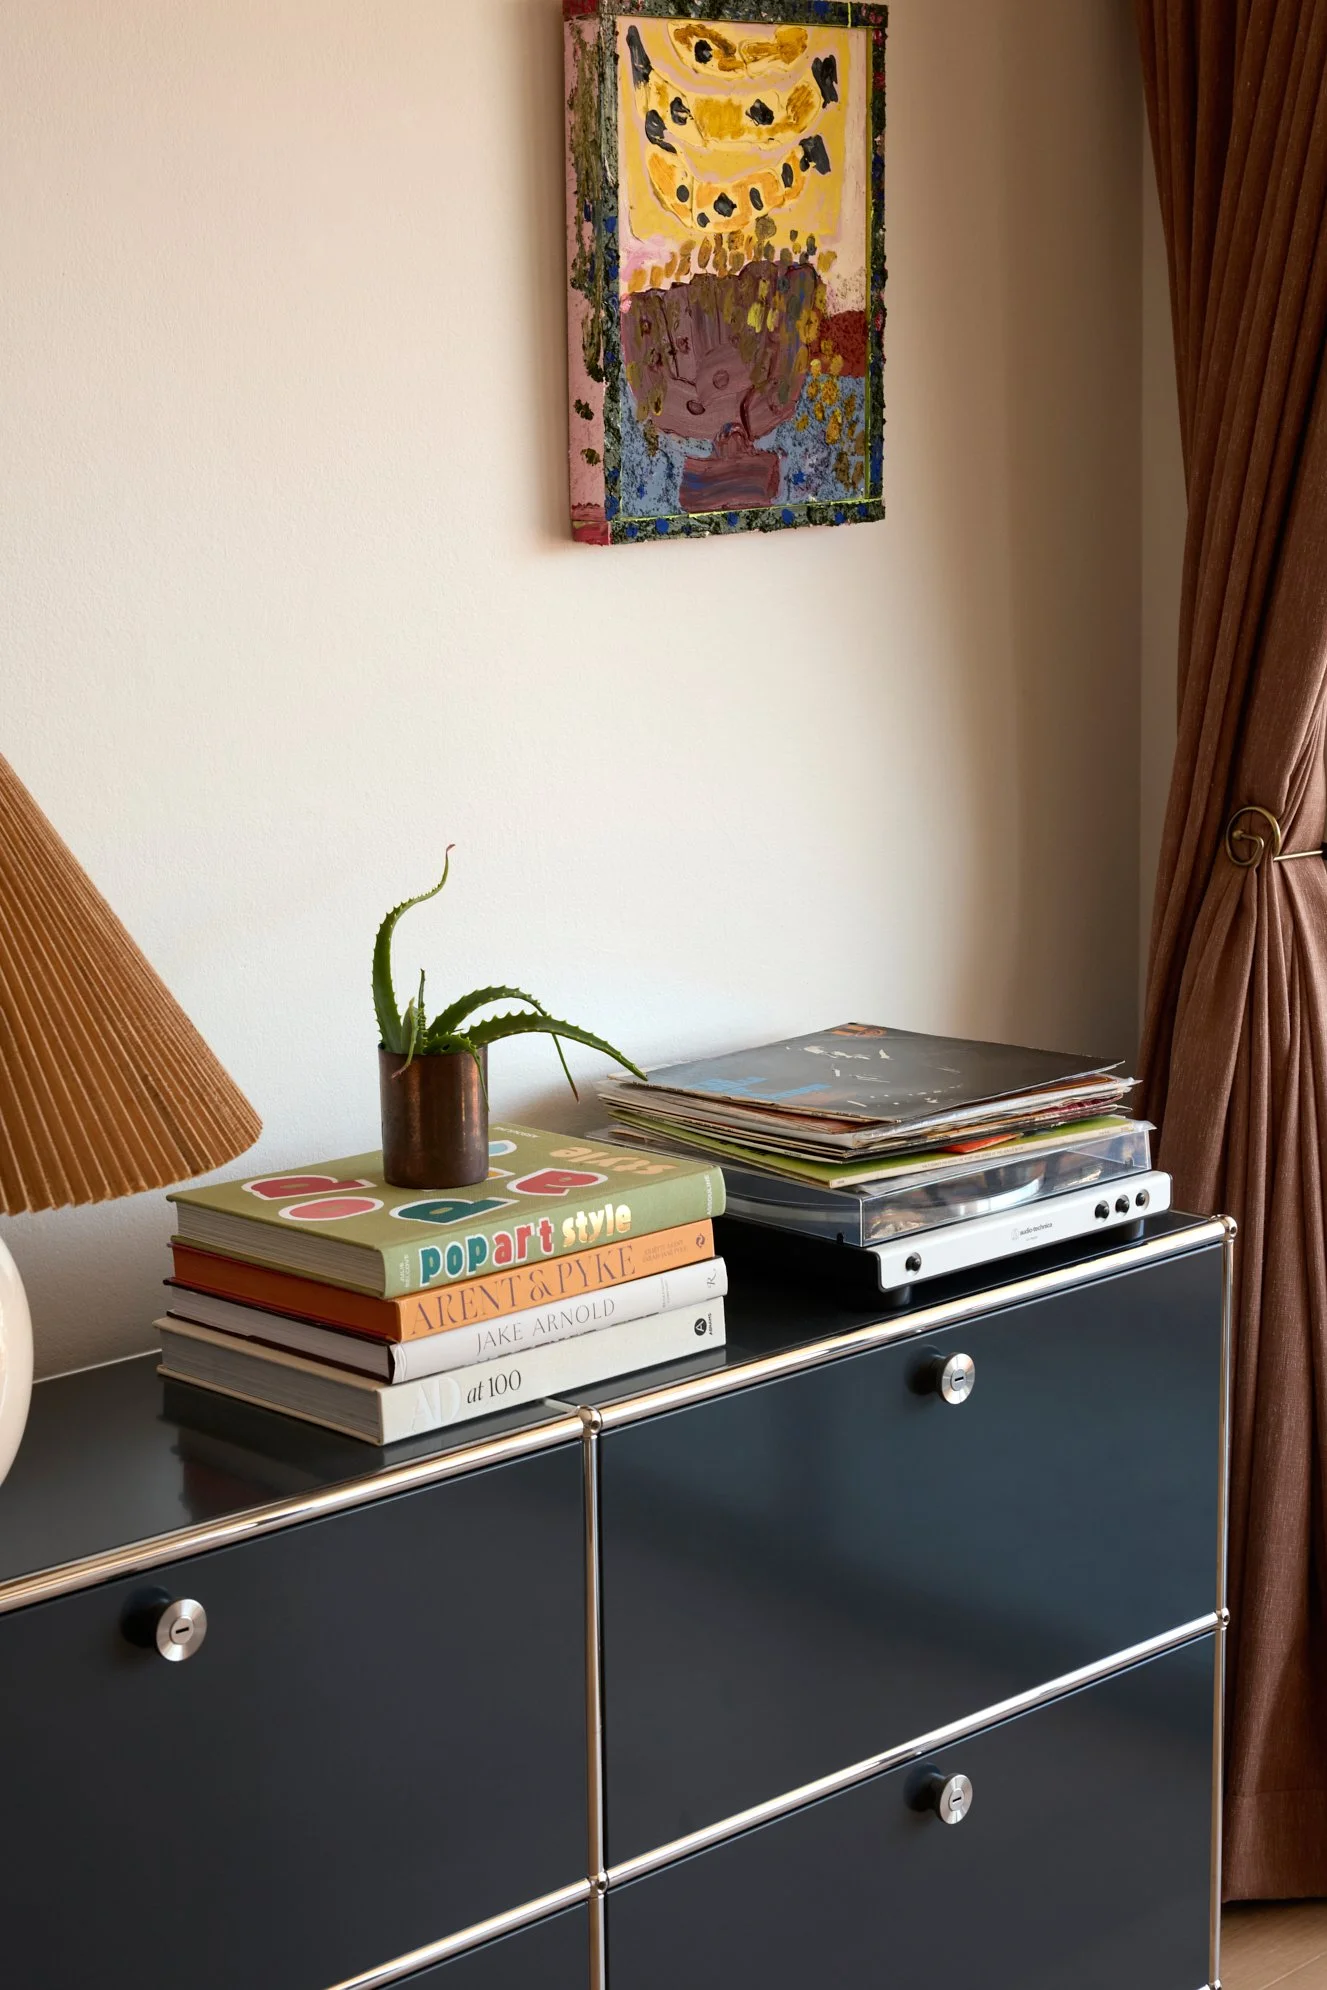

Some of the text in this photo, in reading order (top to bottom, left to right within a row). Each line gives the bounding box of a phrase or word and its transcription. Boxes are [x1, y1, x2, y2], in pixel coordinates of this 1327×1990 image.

[562, 1203, 631, 1248] style
[410, 1274, 521, 1336] ARENT
[529, 1268, 552, 1301] &
[556, 1244, 636, 1294] PYKE
[476, 1298, 615, 1356] JAKE ARNOLD
[411, 1369, 522, 1432] AD at 100
